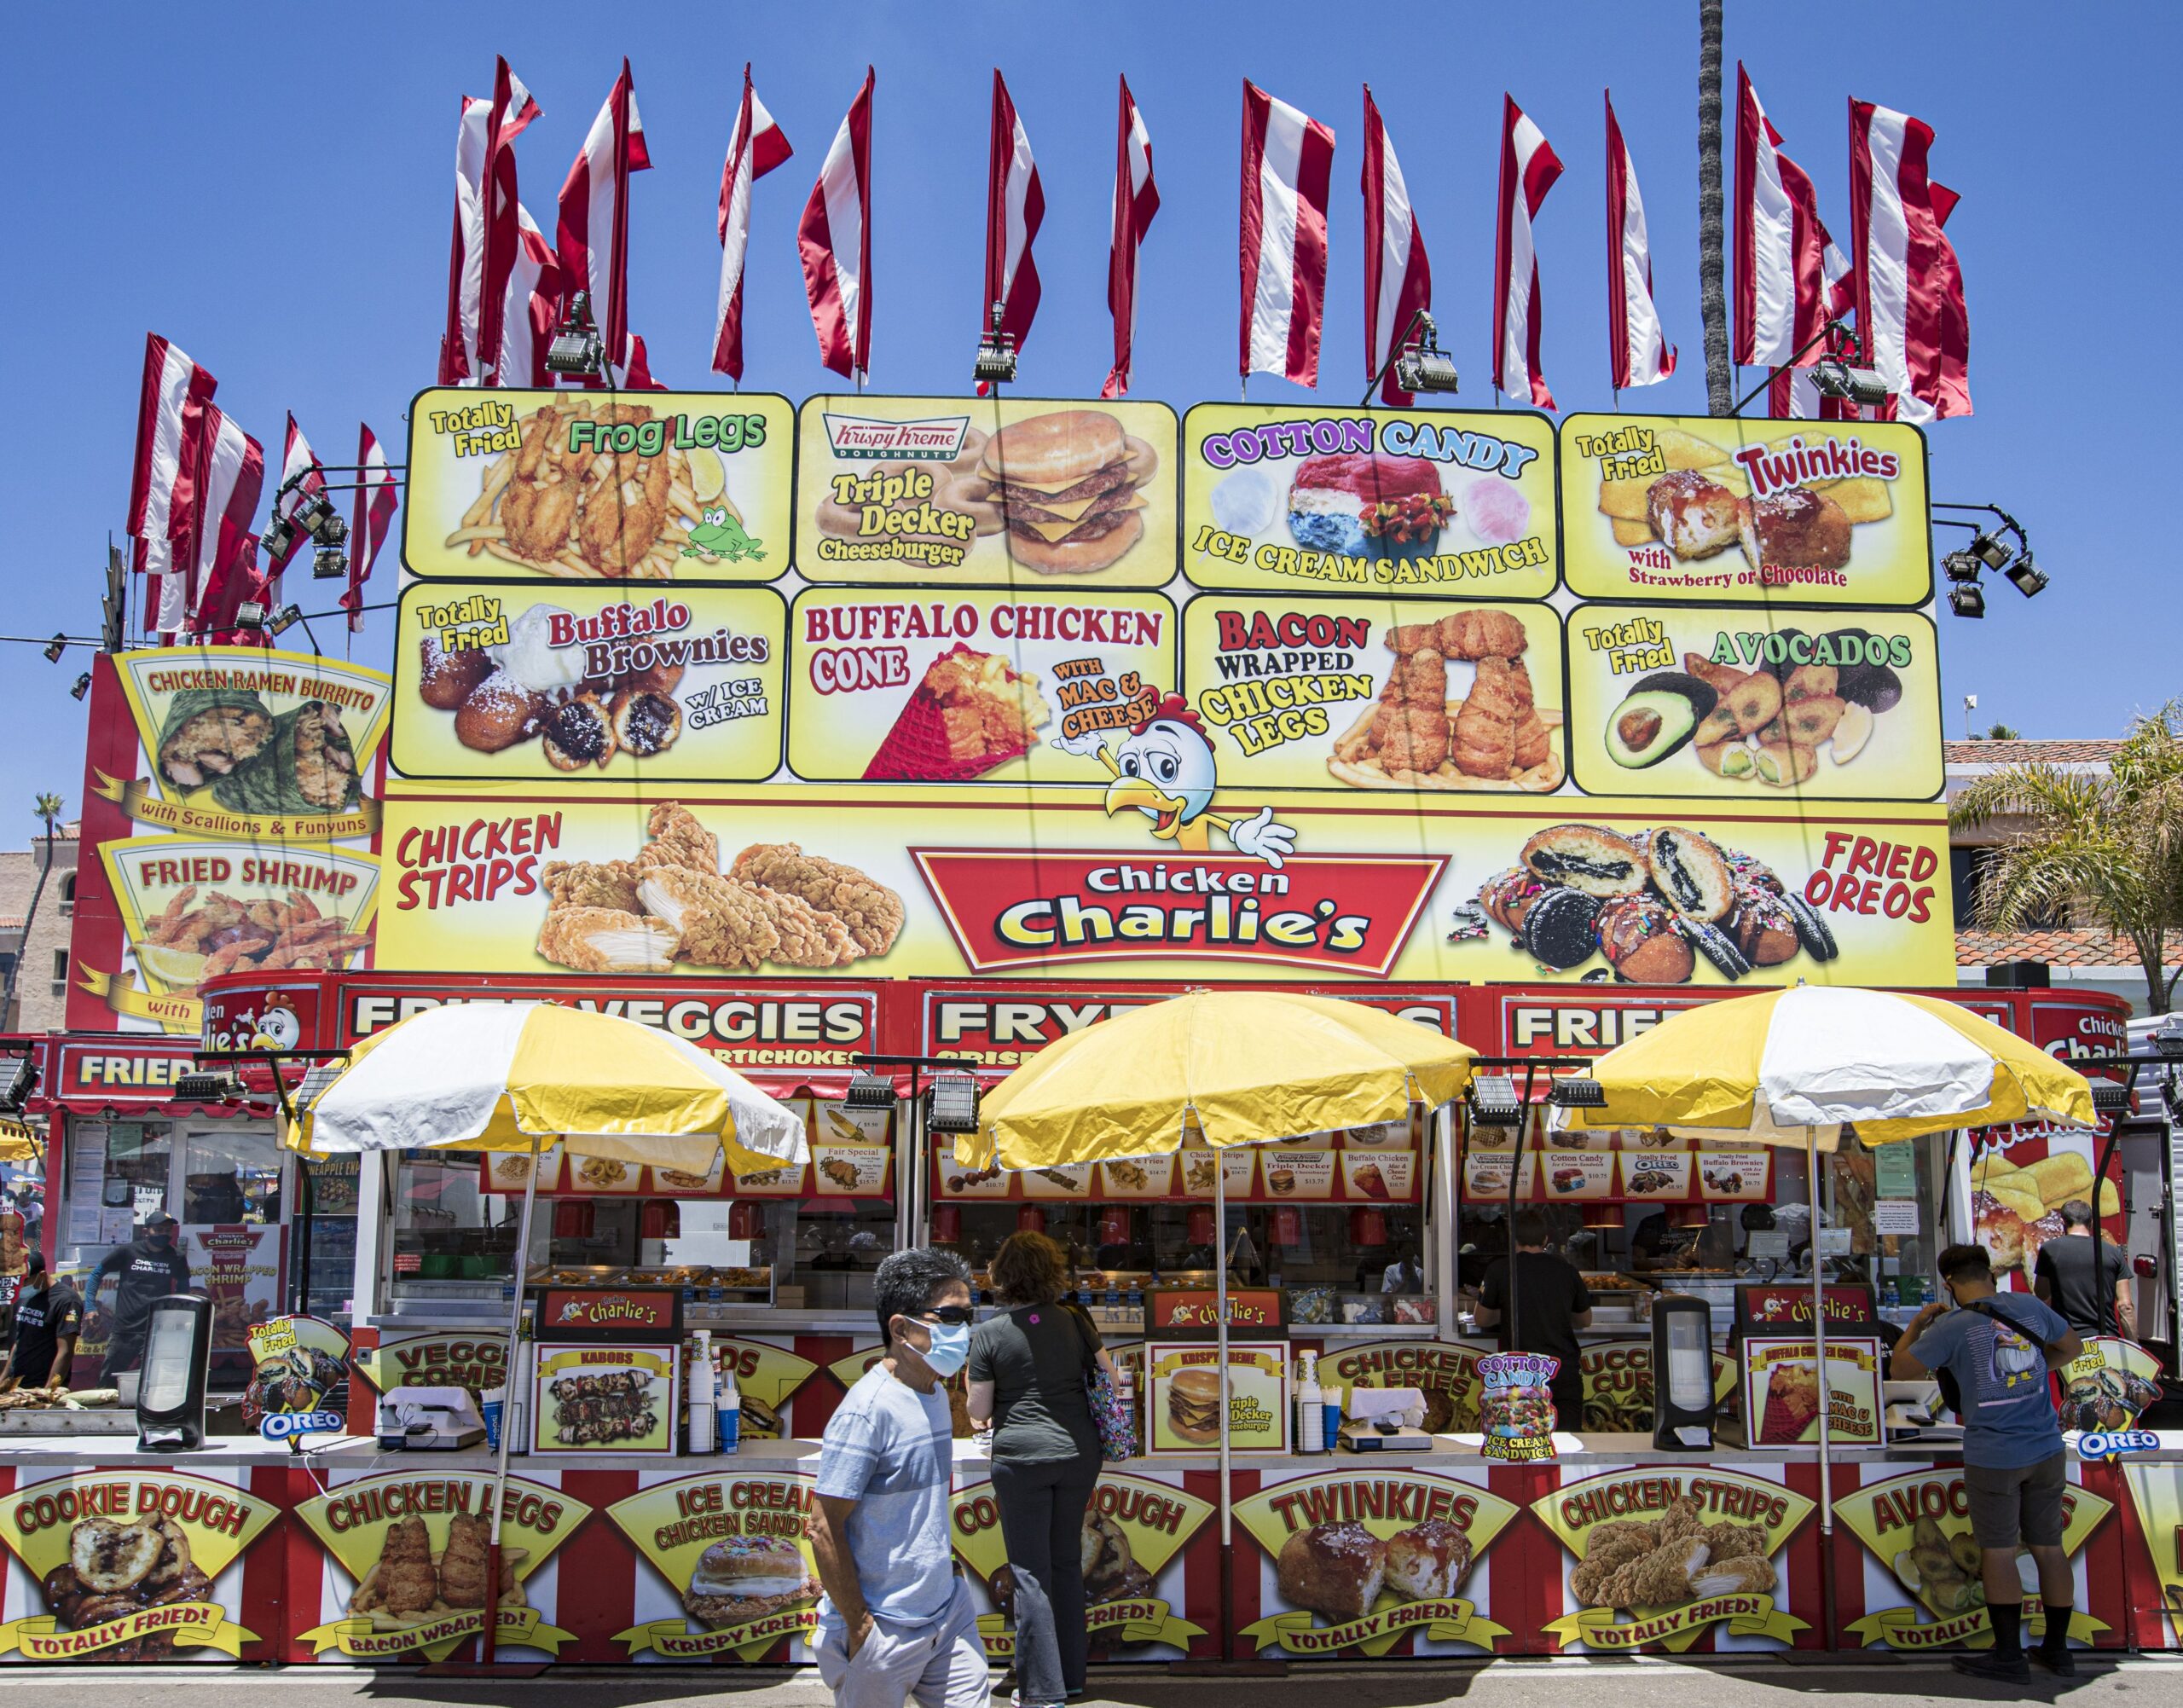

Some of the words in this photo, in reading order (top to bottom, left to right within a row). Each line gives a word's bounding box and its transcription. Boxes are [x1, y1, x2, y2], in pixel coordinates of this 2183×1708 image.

[430, 401, 512, 434] Totally
[455, 420, 521, 457] Fried
[569, 420, 663, 456] Frog
[674, 414, 766, 454] Legs
[835, 426, 895, 448] Krispy
[895, 426, 956, 447] Kreme
[1202, 419, 1375, 469] COTTON
[1381, 420, 1538, 479] CANDY
[1576, 426, 1655, 458] Totally
[1601, 444, 1665, 481] Fried
[1734, 437, 1899, 499] Twinkies
[831, 466, 934, 507] Triple
[859, 506, 976, 541] Decker
[818, 537, 964, 567] Cheeseburger
[1193, 525, 1250, 564] ICE
[1255, 543, 1368, 582] CREAM
[1375, 538, 1549, 584] SANDWICH
[1629, 548, 1671, 570] with
[1629, 567, 1732, 588] Strawberry
[1738, 570, 1757, 584] or
[1761, 565, 1847, 587] Chocolate
[417, 595, 501, 628] Totally
[547, 599, 690, 647] Buffalo
[805, 604, 979, 643] BUFFALO
[990, 605, 1163, 647] CHICKEN
[441, 617, 510, 653] Fried
[1215, 611, 1371, 651] BACON
[1584, 617, 1664, 651] Totally
[584, 629, 767, 678] Brownies
[1215, 652, 1353, 680] WRAPPED
[1609, 637, 1675, 675] Fried
[1710, 631, 1912, 668] AVOCADOS
[809, 646, 910, 695] CONE
[1052, 658, 1104, 681] WITH
[148, 669, 229, 693] CHICKEN
[233, 670, 295, 693] RAMEN
[300, 680, 375, 711] BURRITO
[686, 686, 719, 709] w/
[722, 680, 761, 698] ICE
[1057, 679, 1116, 710] MAC
[1119, 671, 1141, 697] &
[1200, 675, 1372, 726] CHICKEN
[688, 698, 767, 728] CREAM
[1062, 693, 1159, 740] CHEESE
[1231, 707, 1329, 756] LEGS
[141, 802, 177, 823] with
[182, 812, 261, 834] Scallions
[270, 820, 285, 834] &
[294, 816, 367, 835] Funyuns
[397, 812, 562, 868] CHICKEN
[1822, 831, 1938, 883] FRIED
[139, 857, 232, 888] FRIED
[241, 858, 358, 896] SHRIMP
[397, 856, 539, 910] STRIPS
[1085, 863, 1290, 895] Chicken
[1805, 868, 1935, 923] OREOS
[993, 894, 1372, 952] Charlie's
[147, 999, 190, 1018] with
[78, 1056, 195, 1087] FRIED
[848, 1148, 878, 1156] Special
[1223, 1151, 1244, 1160] Strips
[1579, 1155, 1603, 1163] Candy
[1636, 1161, 1679, 1171] OREO
[135, 1259, 170, 1268] CHICKEN
[205, 1274, 252, 1286] SHRIMP
[223, 1265, 277, 1277] WRAPPED
[589, 1300, 657, 1323] Charlie's
[250, 1319, 291, 1340] Totally
[263, 1329, 297, 1352] Fried
[76, 1345, 92, 1354] Rice
[93, 1345, 100, 1353] &
[581, 1352, 634, 1364] KABOBS
[1478, 1356, 1557, 1375] COTTON
[1837, 1346, 1859, 1361] CONE
[2072, 1351, 2105, 1372] Fried
[1383, 1369, 1472, 1397] FRIES
[1485, 1371, 1547, 1388] CANDY
[1828, 1402, 1856, 1419] MAC
[1858, 1408, 1870, 1421] &
[1830, 1391, 1855, 1404] WITH
[264, 1412, 341, 1437] OREO
[1229, 1409, 1272, 1421] Decker
[1484, 1445, 1555, 1460] SANDWICH
[1486, 1435, 1507, 1447] ICE
[1509, 1435, 1550, 1448] CREAM
[2081, 1432, 2157, 1455] OREO
[13, 1482, 130, 1535] COOKIE
[137, 1482, 252, 1537] DOUGH
[325, 1480, 472, 1533] CHICKEN
[479, 1484, 564, 1534] LEGS
[677, 1484, 724, 1517] ICE
[1270, 1479, 1479, 1534] TWINKIES
[1560, 1477, 1683, 1531] CHICKEN
[1689, 1477, 1790, 1529] STRIPS
[654, 1515, 741, 1551] CHICKEN
[28, 1622, 128, 1655] TOTALLY
[133, 1606, 210, 1631] FRIED!
[1286, 1620, 1378, 1650] TOTALLY
[1386, 1601, 1461, 1625] FRIED!
[1590, 1616, 1681, 1647] TOTALLY
[1687, 1596, 1759, 1622] FRIED!
[1891, 1613, 1983, 1645] TOTALLY
[347, 1631, 418, 1653] BACON
[661, 1628, 747, 1654] KRISPY
